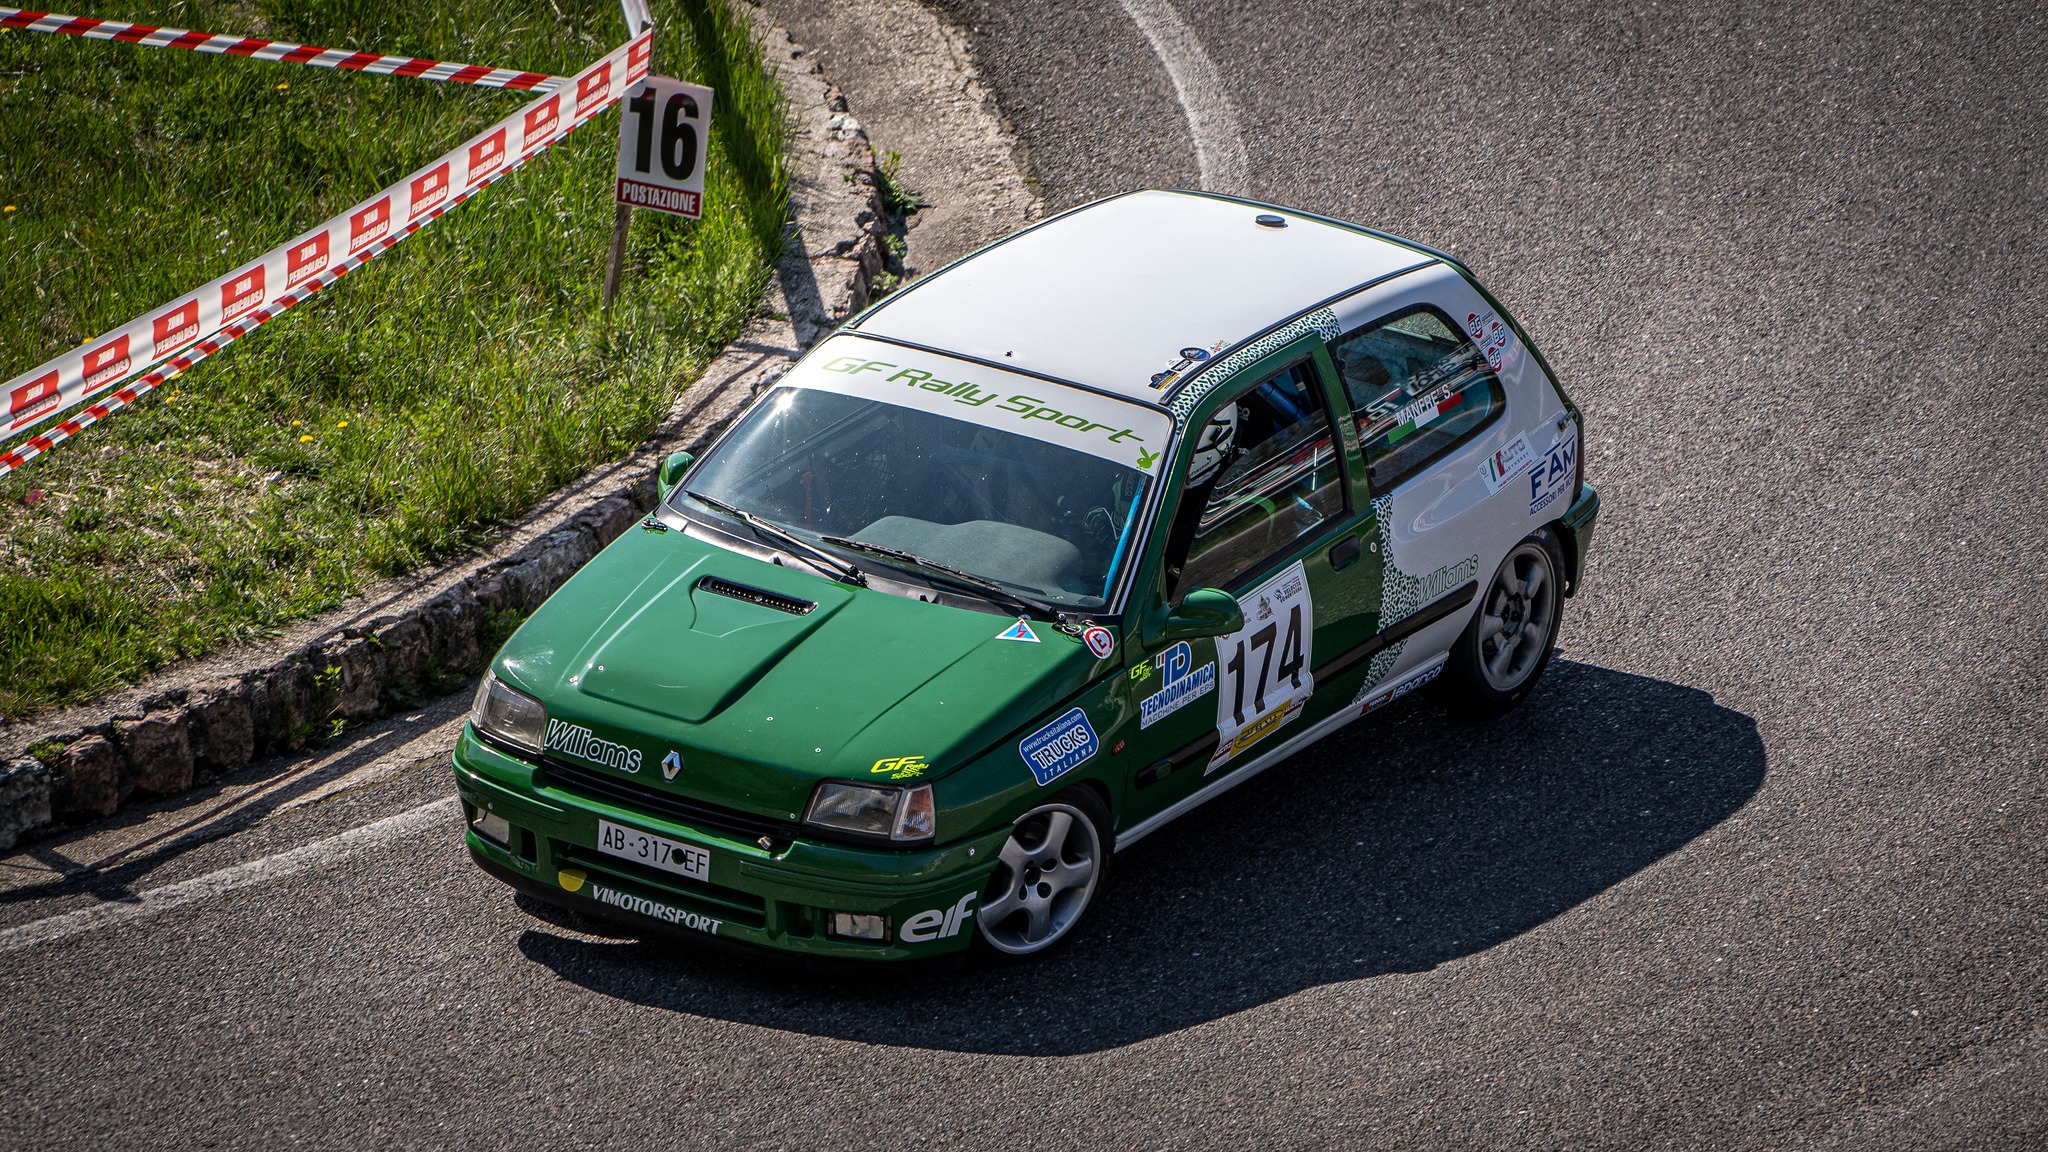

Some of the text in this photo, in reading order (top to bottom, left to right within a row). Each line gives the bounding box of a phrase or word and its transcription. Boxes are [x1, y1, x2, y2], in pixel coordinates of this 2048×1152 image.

[587, 72, 601, 91] ZONA
[578, 84, 609, 111] PERICOLOSA
[535, 106, 548, 125] ZONA
[524, 117, 557, 147] PERICOLOSA
[629, 87, 699, 181] 16
[480, 140, 495, 159] ZONA
[469, 151, 503, 181] PERICOLOSA
[423, 174, 438, 193] ZONA
[622, 182, 696, 213] POSTAZIONE
[411, 185, 447, 216] PERICOLOSA
[363, 208, 378, 228] ZONA
[352, 219, 388, 250] PERICOLOSA
[301, 242, 317, 262] ZONA
[288, 254, 328, 285] PERICOLOSA
[235, 277, 251, 296] ZONA
[223, 289, 264, 320] PERICOLOSA
[167, 312, 184, 331] ZONA
[156, 323, 198, 354] PERICOLOSA
[97, 347, 115, 367] ZONA
[86, 358, 130, 389] PERICOLOSA
[25, 383, 44, 403] ZONA
[822, 357, 1145, 443] GF Rally Sport
[1531, 440, 1575, 500] FAM
[1530, 491, 1557, 517] ACCESSORI
[1419, 554, 1479, 605] Williams
[1131, 659, 1149, 679] GF
[1227, 604, 1304, 728] 174
[1141, 662, 1214, 719] TECNODINAMICA
[1395, 666, 1441, 698] sparco
[1142, 680, 1214, 727] MACCHINE PER EPS
[544, 718, 643, 774] Williams
[1023, 713, 1082, 753] www.trucksitaliana.com
[1030, 725, 1090, 769] TRUCKS
[871, 756, 924, 773] GF
[1044, 745, 1093, 779] ITALIANA
[592, 885, 722, 935] VIMOTORSPORT
[900, 891, 978, 943] elf
